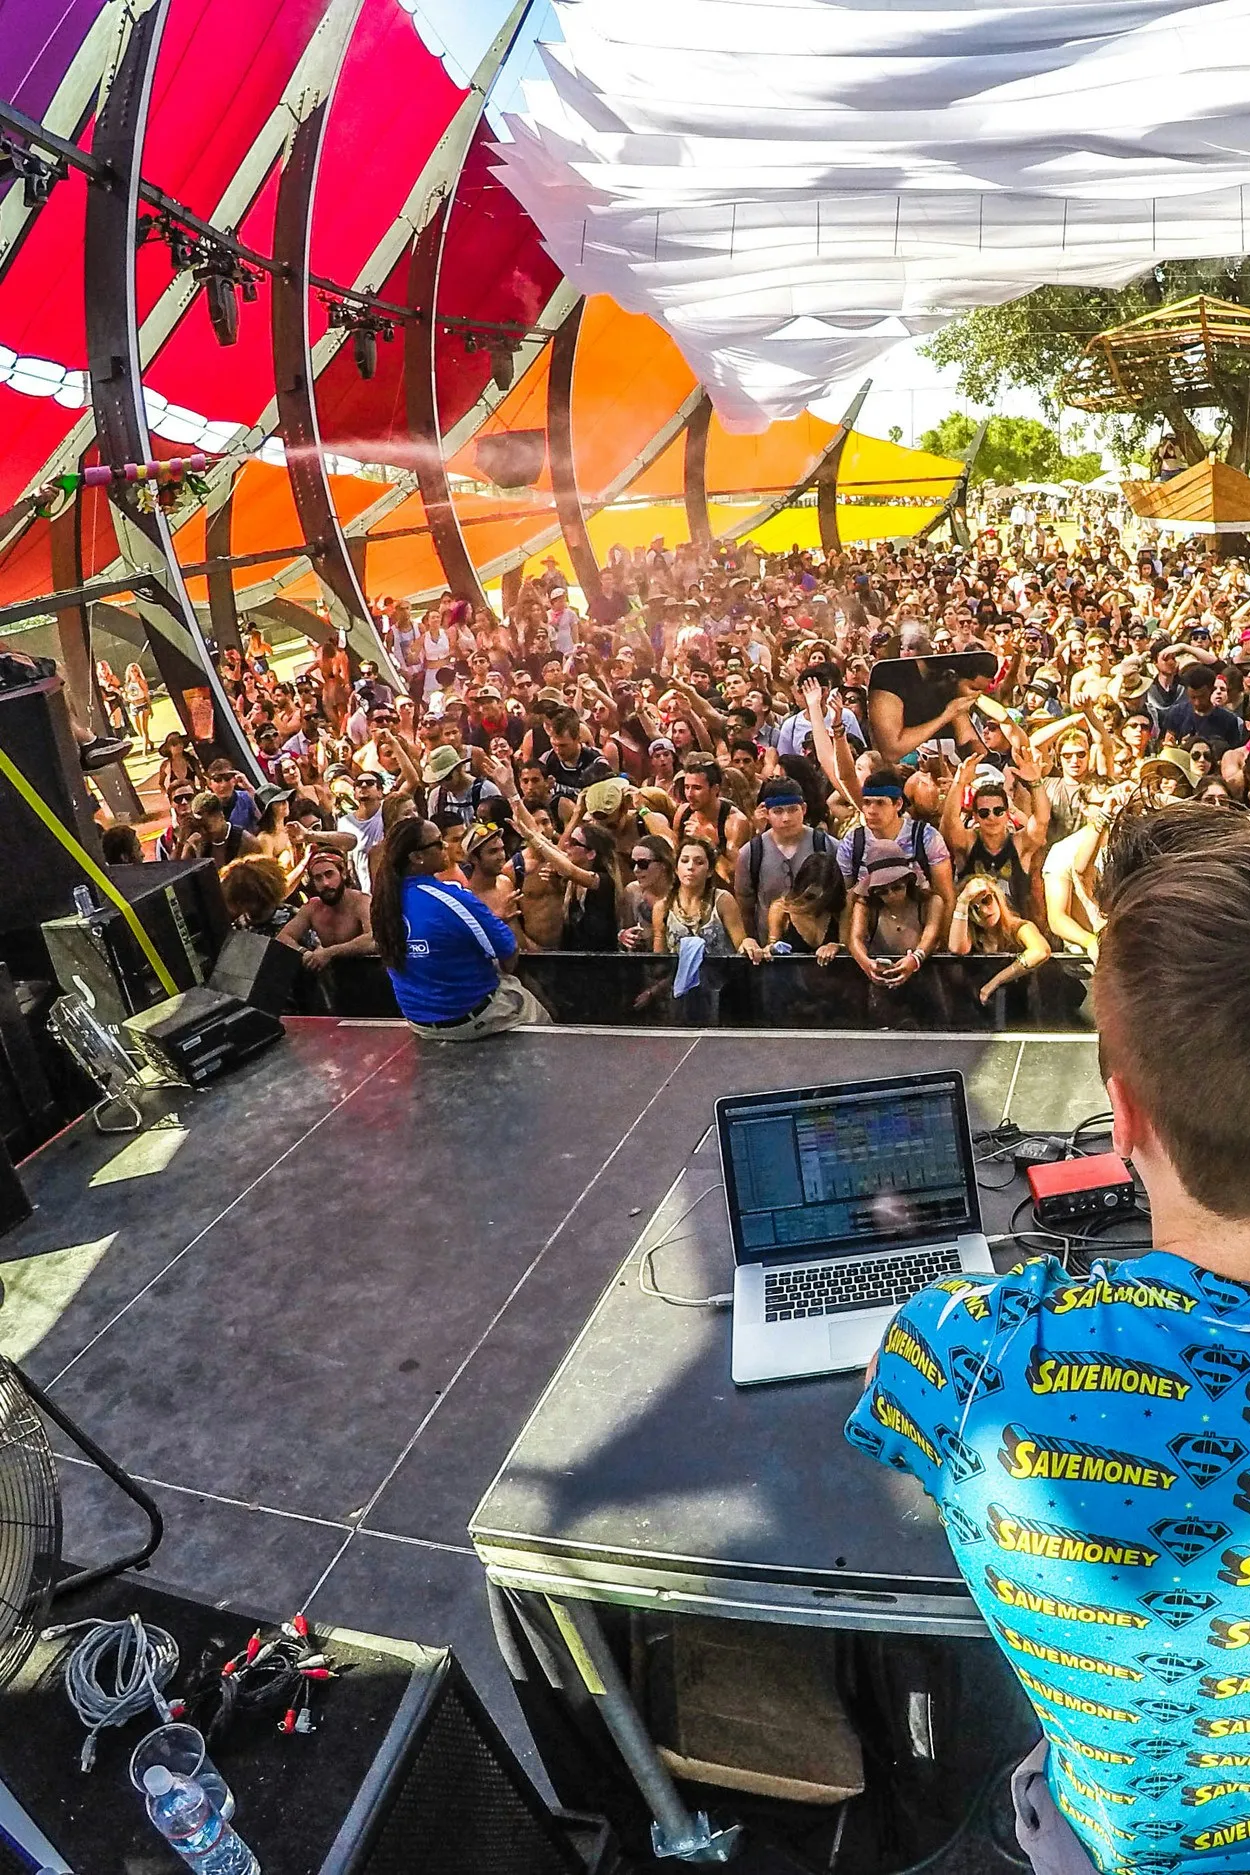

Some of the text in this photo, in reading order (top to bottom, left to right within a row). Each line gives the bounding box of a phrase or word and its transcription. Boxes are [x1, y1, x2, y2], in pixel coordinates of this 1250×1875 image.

[885, 1323, 947, 1390] SAVEMONEY
[1032, 1360, 1191, 1400] SAVEMONEY
[877, 1396, 943, 1468] SAVEMONEY
[1008, 1441, 1179, 1490] SAVEMONEY
[996, 1519, 1160, 1567] SAVEMONEY
[995, 1579, 1151, 1629] SAVEMONEY
[1003, 1627, 1146, 1682] SAVEMONEY
[1018, 1667, 1142, 1724] SAVEMONEY
